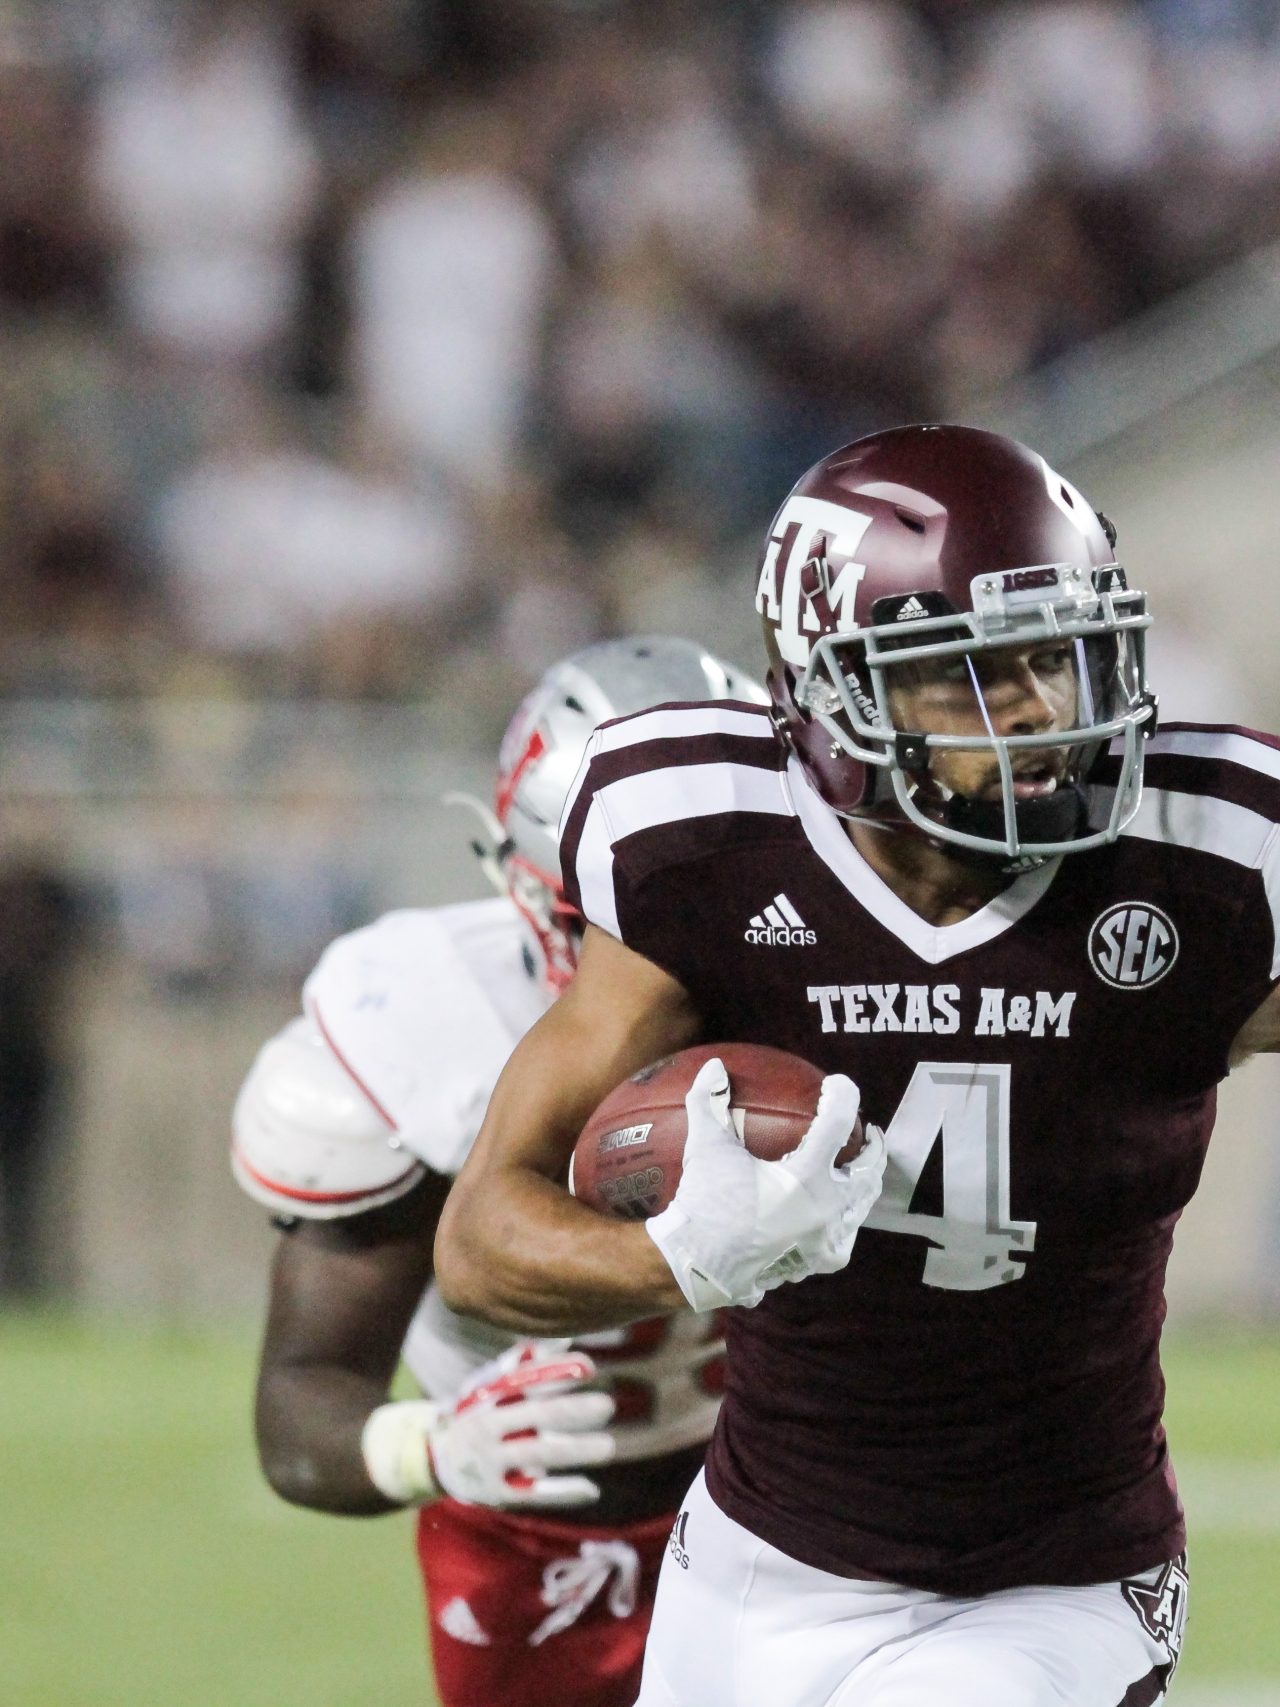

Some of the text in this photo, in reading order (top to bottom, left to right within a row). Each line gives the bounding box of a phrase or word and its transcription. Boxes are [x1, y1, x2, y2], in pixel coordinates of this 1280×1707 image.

[896, 609, 930, 621] adidas
[744, 924, 818, 947] adidas
[1099, 909, 1173, 982] SEC
[806, 983, 1077, 1038] TEXAS A&M
[859, 1061, 1038, 1291] 4
